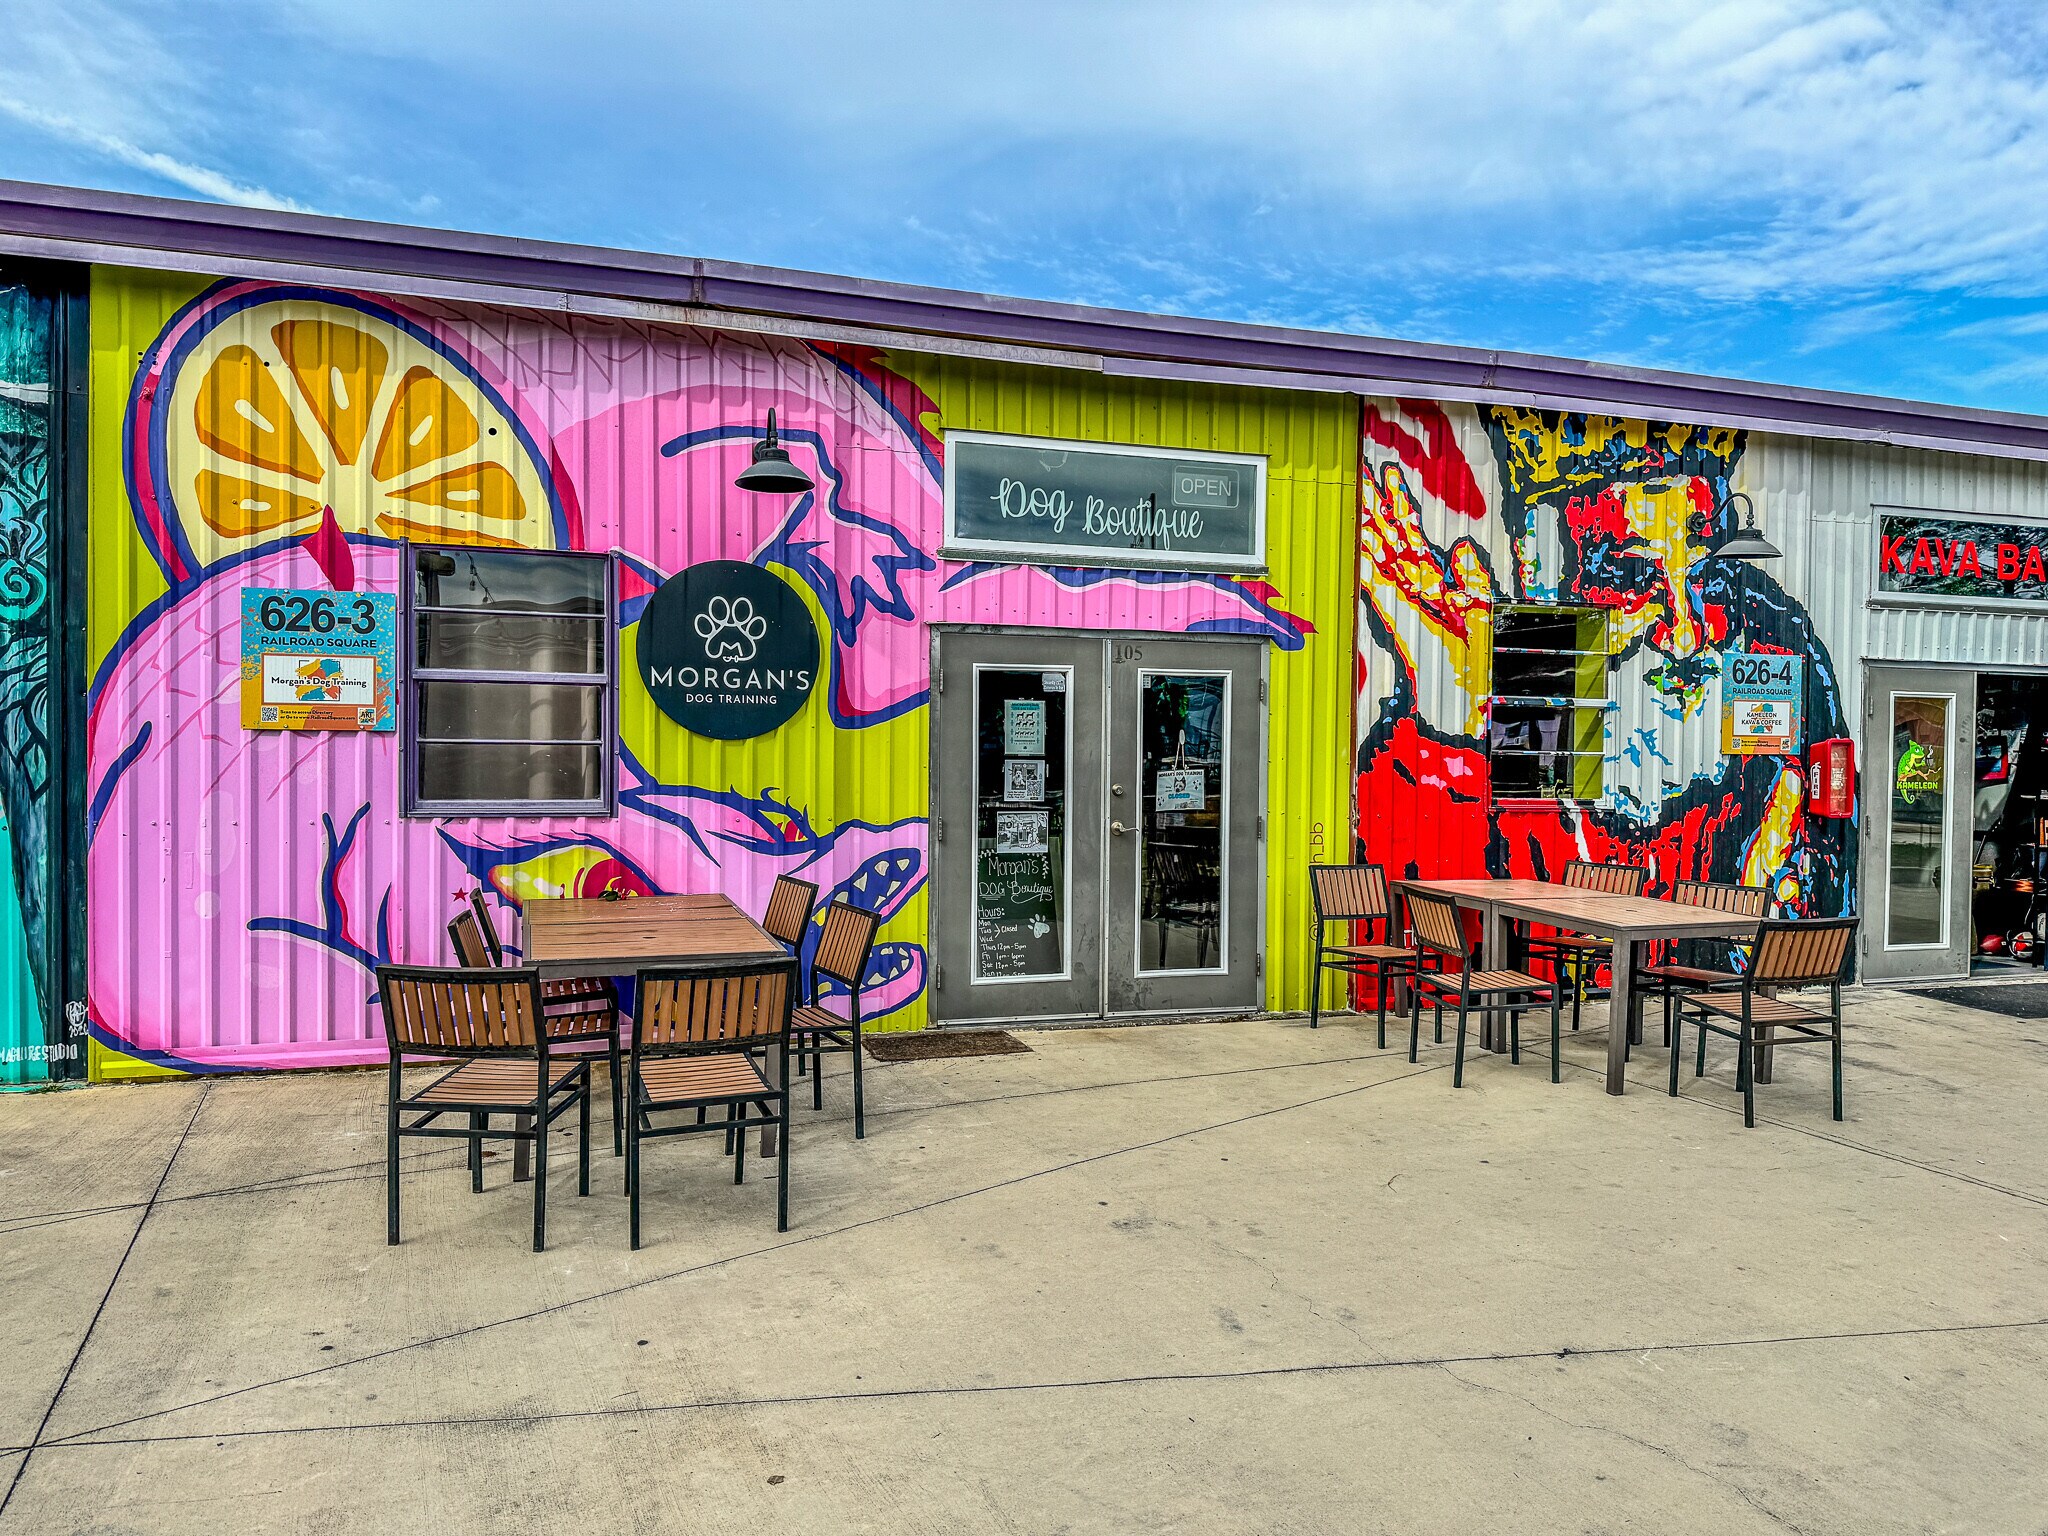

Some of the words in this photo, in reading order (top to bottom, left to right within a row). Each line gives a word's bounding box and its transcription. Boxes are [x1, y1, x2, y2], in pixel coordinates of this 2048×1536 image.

[1181, 478, 1232, 497] OPEN
[990, 477, 1074, 534] Dog
[1082, 495, 1204, 551] Boutique
[1882, 535, 1982, 578] KAVA
[260, 596, 376, 634] 626-3
[261, 636, 324, 646] RAILROAD
[327, 638, 377, 648] SQUARE
[1114, 645, 1143, 662] 105
[650, 666, 810, 690] MORGAN'S
[1732, 659, 1792, 685] 626-4
[271, 676, 311, 686] Morgan's
[312, 678, 330, 687] Dog
[332, 678, 367, 688] Training
[686, 694, 713, 703] DOG
[718, 694, 778, 704] TRAINING
[1896, 781, 1938, 789] KAMELEON
[988, 857, 1039, 882] Morgan's
[979, 882, 1005, 896] DOG
[1007, 881, 1054, 902] Boutique
[978, 905, 1005, 918] Hours:
[1001, 925, 1018, 933] Closed
